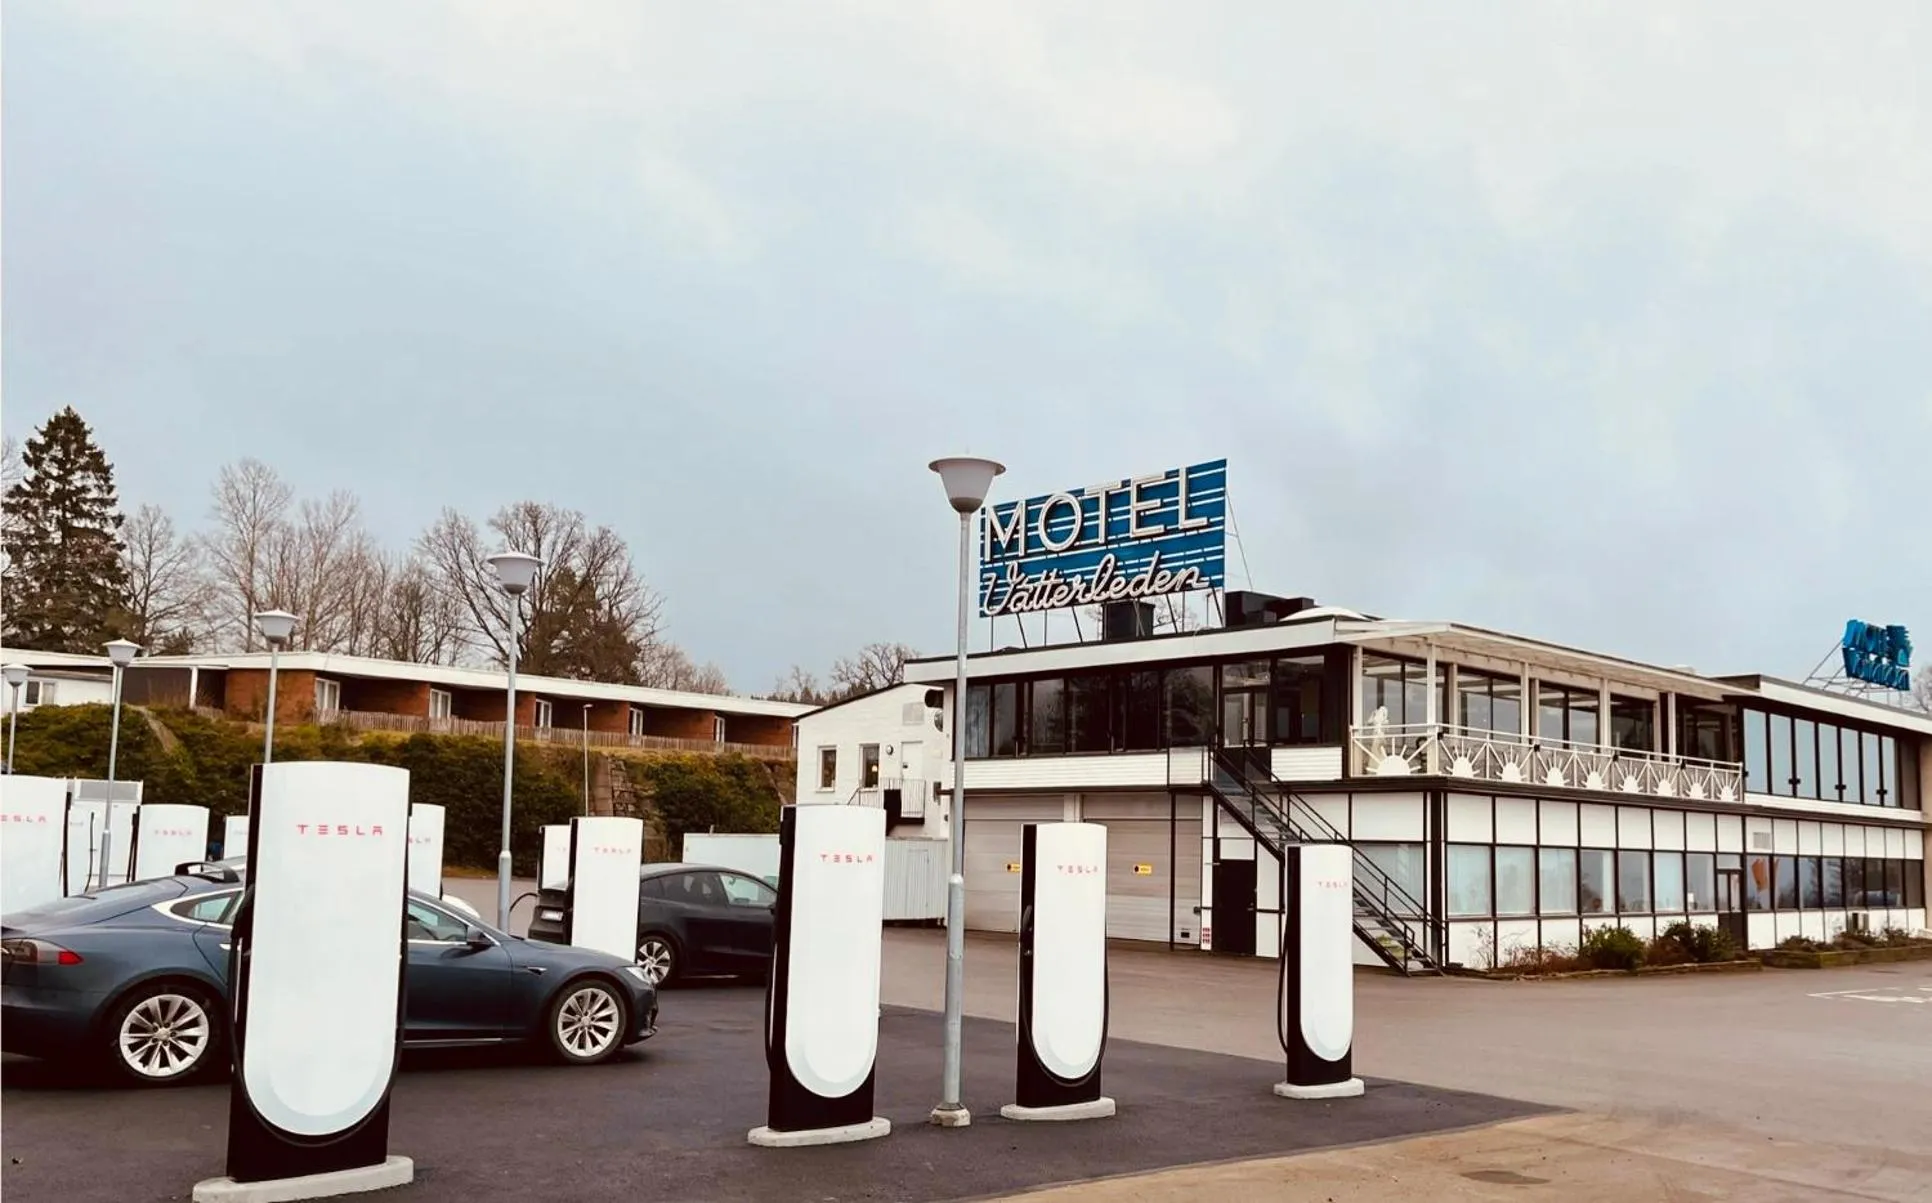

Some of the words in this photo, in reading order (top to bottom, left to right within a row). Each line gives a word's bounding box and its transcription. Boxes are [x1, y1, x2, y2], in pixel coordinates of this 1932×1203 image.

[984, 467, 1208, 562] MOTEL
[982, 551, 1210, 615] Vätterleden
[296, 823, 384, 836] TESLA
[820, 854, 873, 863] TESLA
